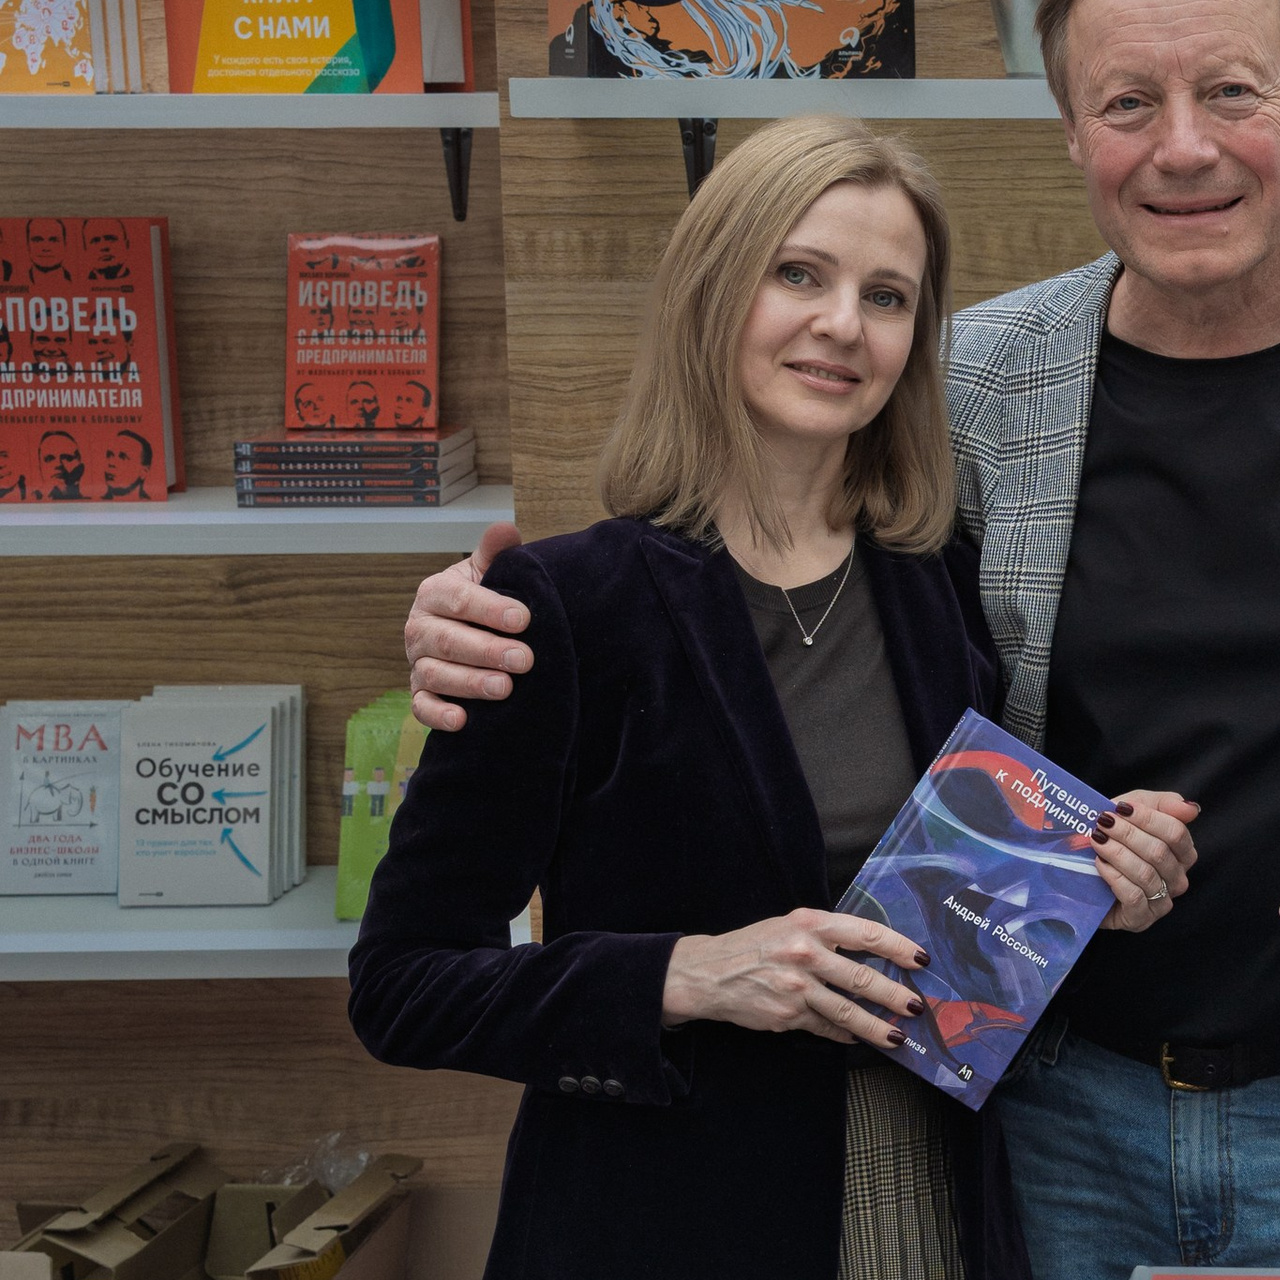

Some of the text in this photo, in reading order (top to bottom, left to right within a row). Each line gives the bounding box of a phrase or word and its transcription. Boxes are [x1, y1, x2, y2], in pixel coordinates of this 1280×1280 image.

[233, 15, 331, 40] С НАМИ
[298, 280, 429, 310] ИСПОВЕДЬ
[296, 328, 428, 347] САМОЗВАНЦА
[295, 349, 429, 366] ПРЕДПРИНИМАТЕЛЯ
[135, 757, 261, 783] Обучение
[994, 769, 1009, 783] к
[1029, 768, 1101, 822] Путешес
[134, 807, 261, 826] СМЫСЛОМ
[943, 894, 1050, 969] Андрей Россохин
